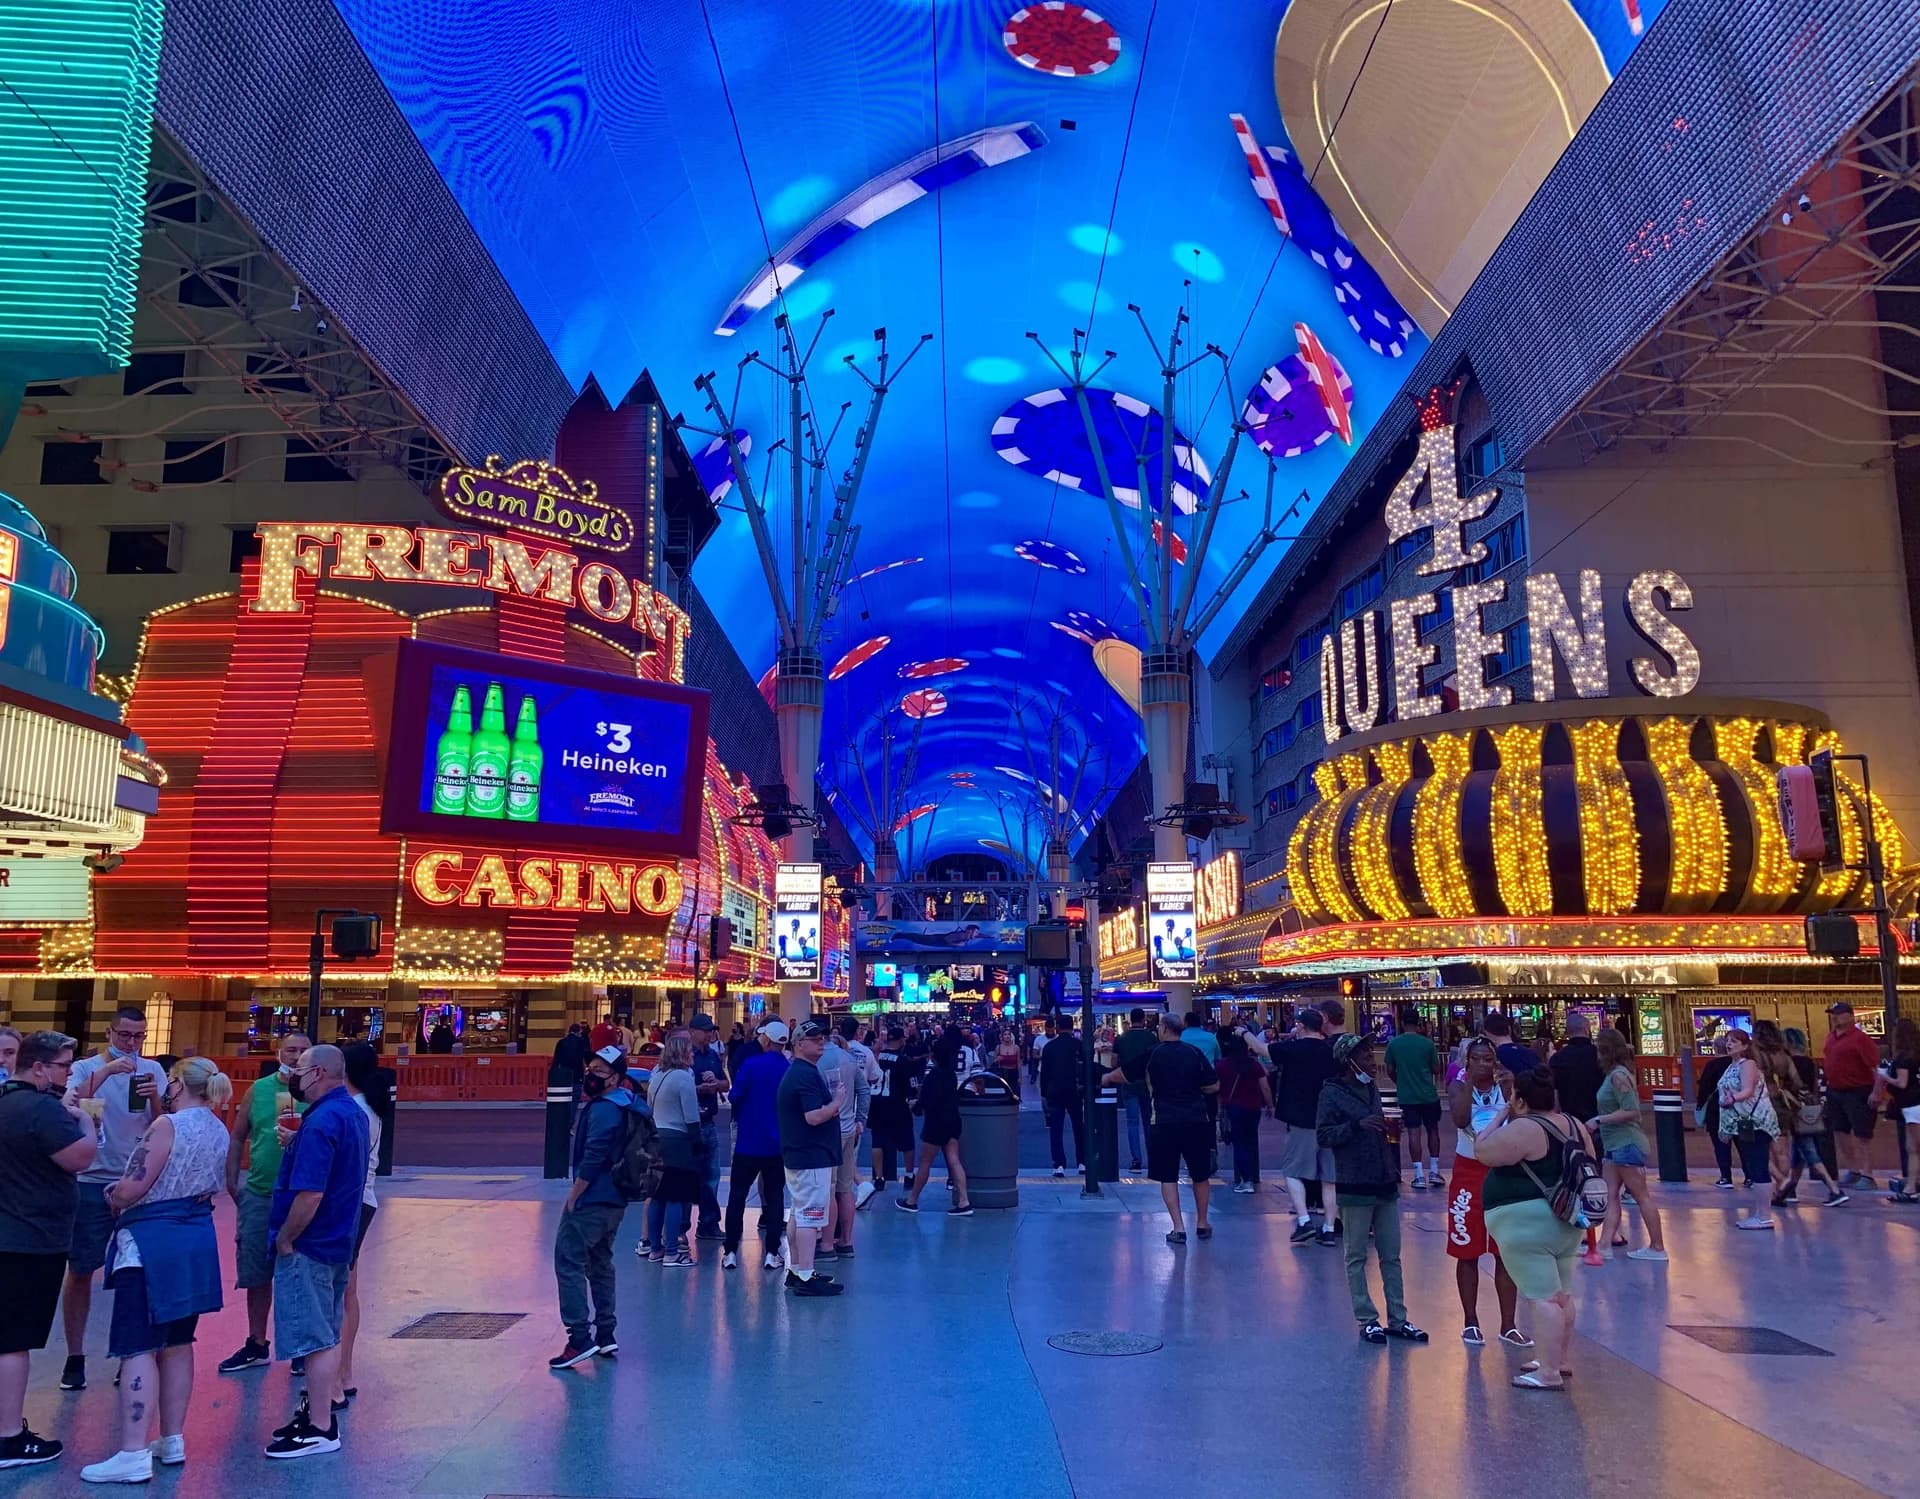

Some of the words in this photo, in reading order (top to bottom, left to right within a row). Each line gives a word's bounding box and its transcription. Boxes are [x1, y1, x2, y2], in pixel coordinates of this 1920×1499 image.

[454, 474, 527, 518] Sam
[533, 493, 623, 543] Boyd's
[1384, 424, 1498, 576] 4
[248, 522, 692, 685] FREMONT
[1320, 568, 1701, 745] QUEENS
[561, 749, 668, 779] Heineken
[595, 720, 633, 754] $3
[469, 775, 506, 787] Heineken
[506, 784, 539, 793] eineken
[589, 792, 636, 807] FREMONT
[411, 850, 684, 916] CASINO
[1450, 1188, 1473, 1246] Cookies
